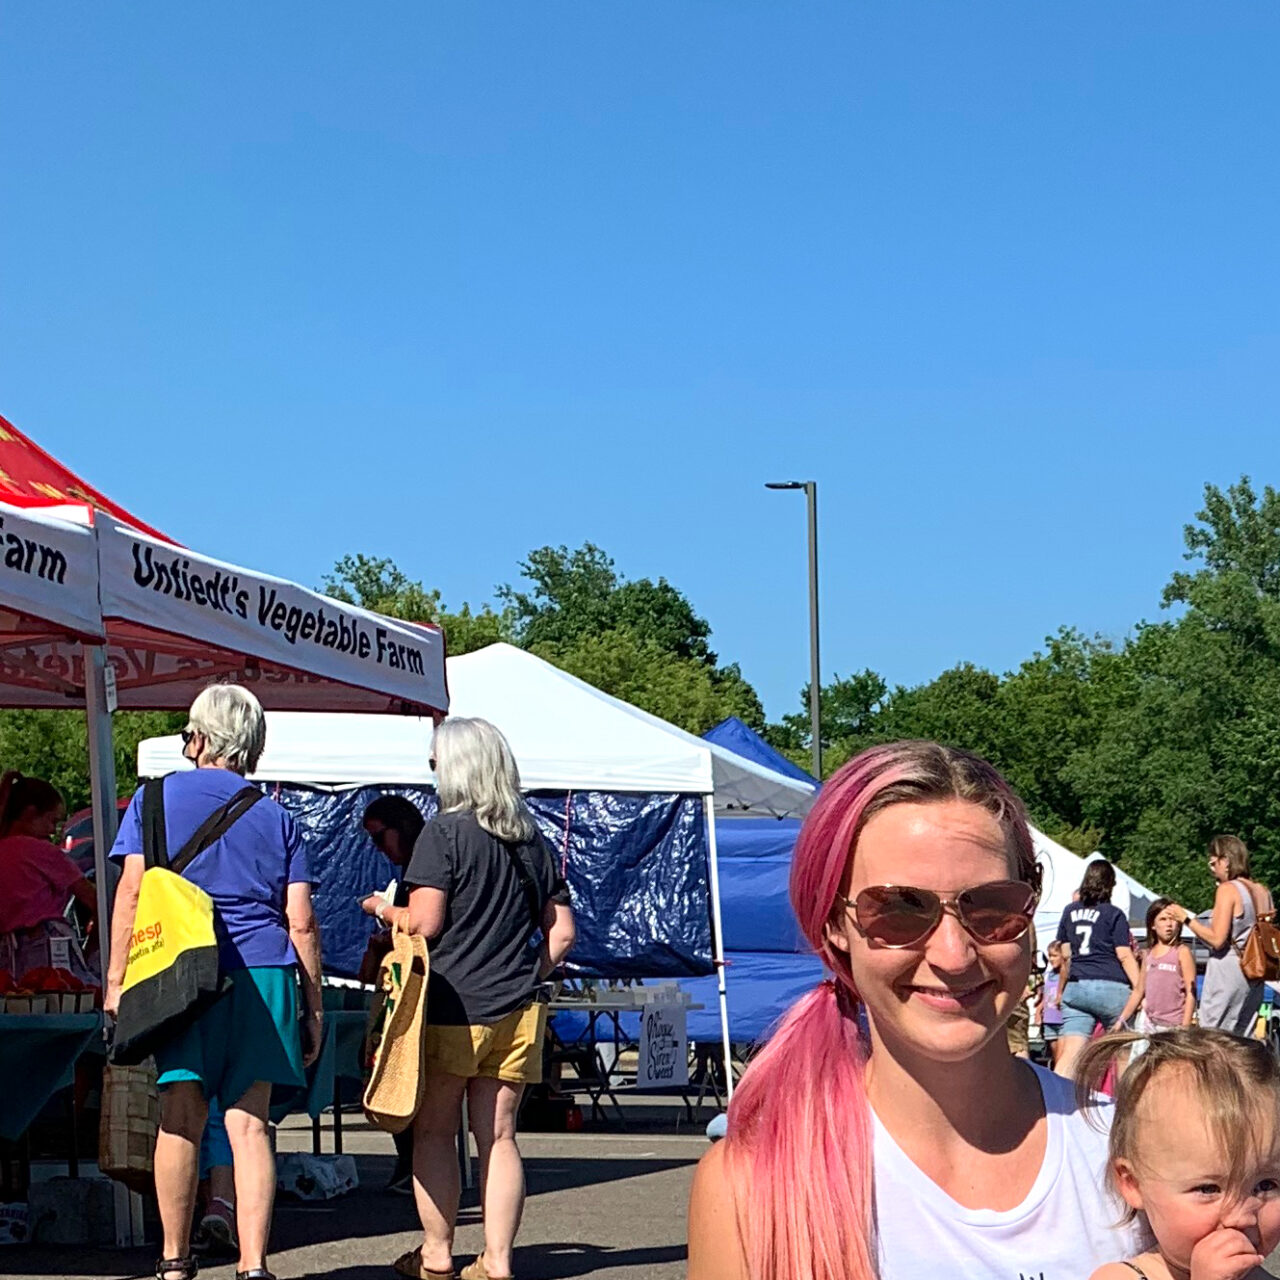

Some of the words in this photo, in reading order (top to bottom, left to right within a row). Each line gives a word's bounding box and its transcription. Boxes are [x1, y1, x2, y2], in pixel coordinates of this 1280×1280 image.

[132, 542, 249, 618] Untiedt's
[258, 586, 371, 659] Vegetable
[376, 628, 425, 676] Farm
[1075, 925, 1093, 955] 7
